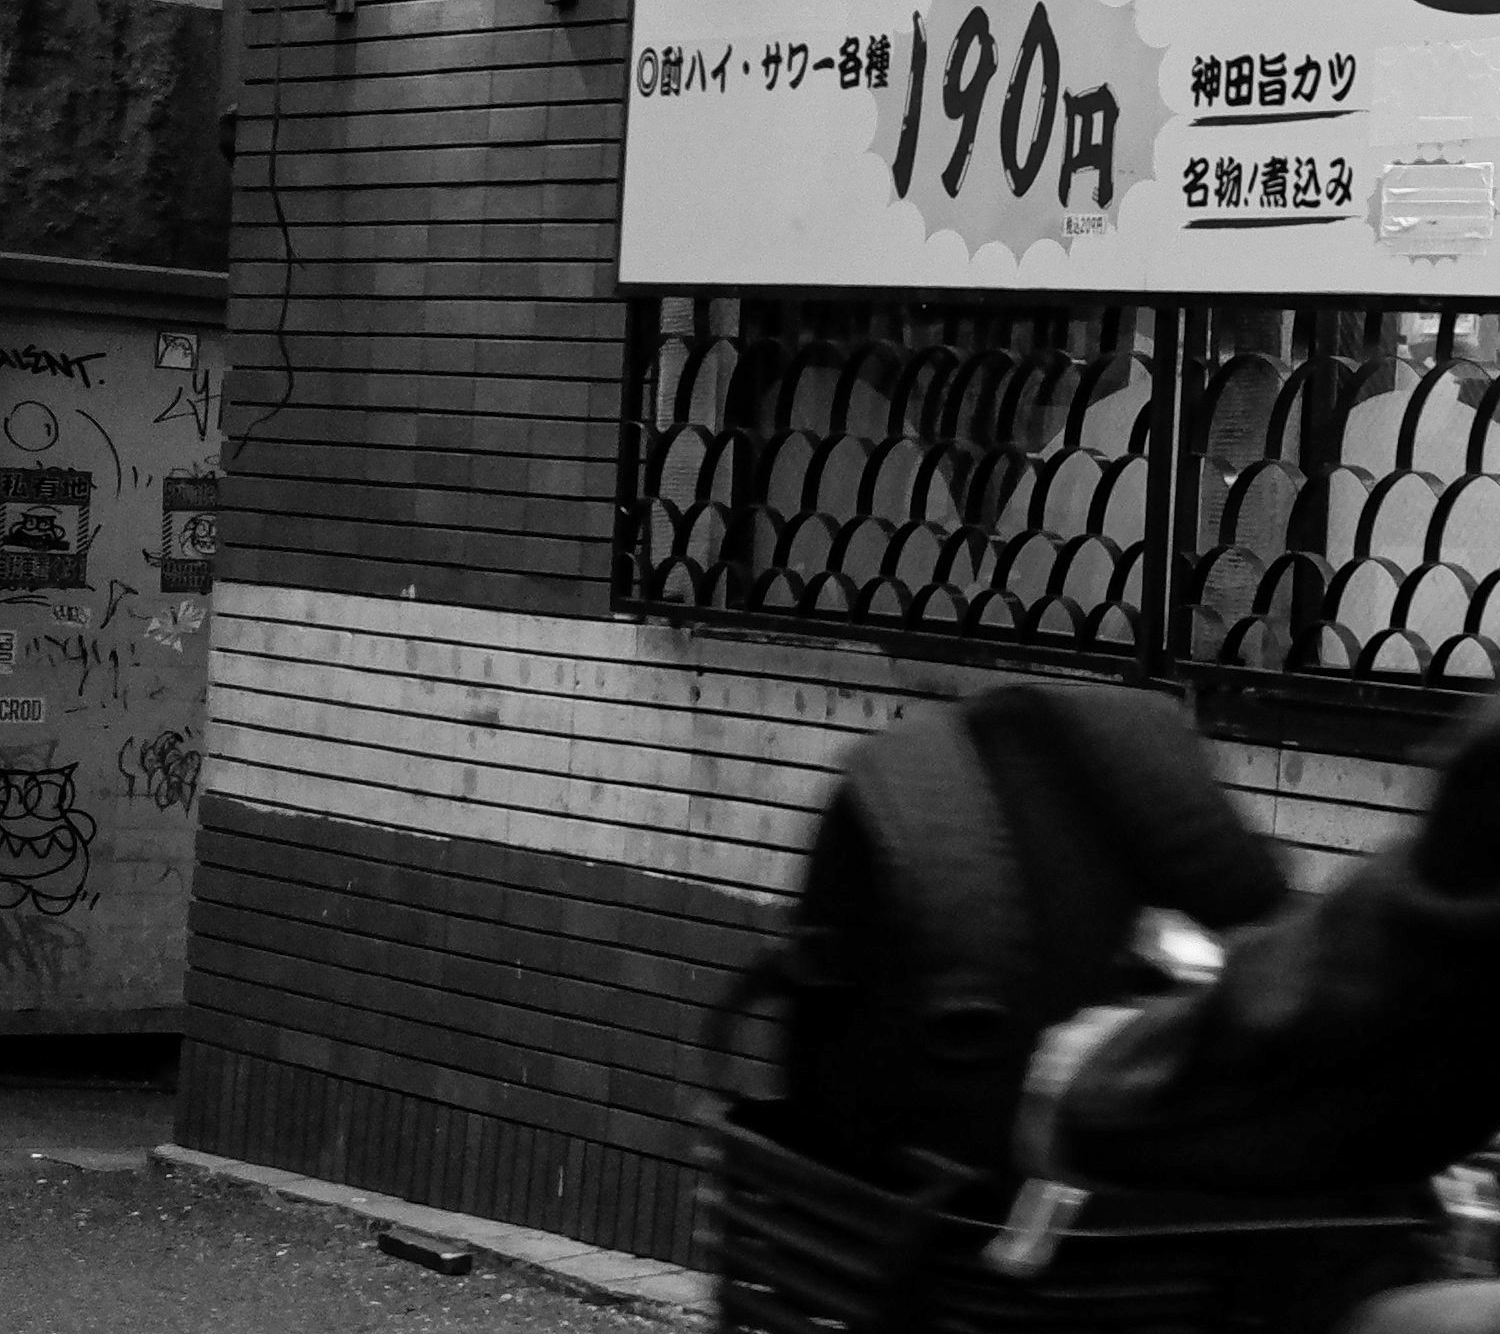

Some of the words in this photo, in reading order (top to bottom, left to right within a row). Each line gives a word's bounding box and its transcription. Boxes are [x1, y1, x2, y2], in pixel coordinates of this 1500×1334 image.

[891, 0, 1120, 210] 190円
[1189, 52, 1356, 108] 神田旨カツ
